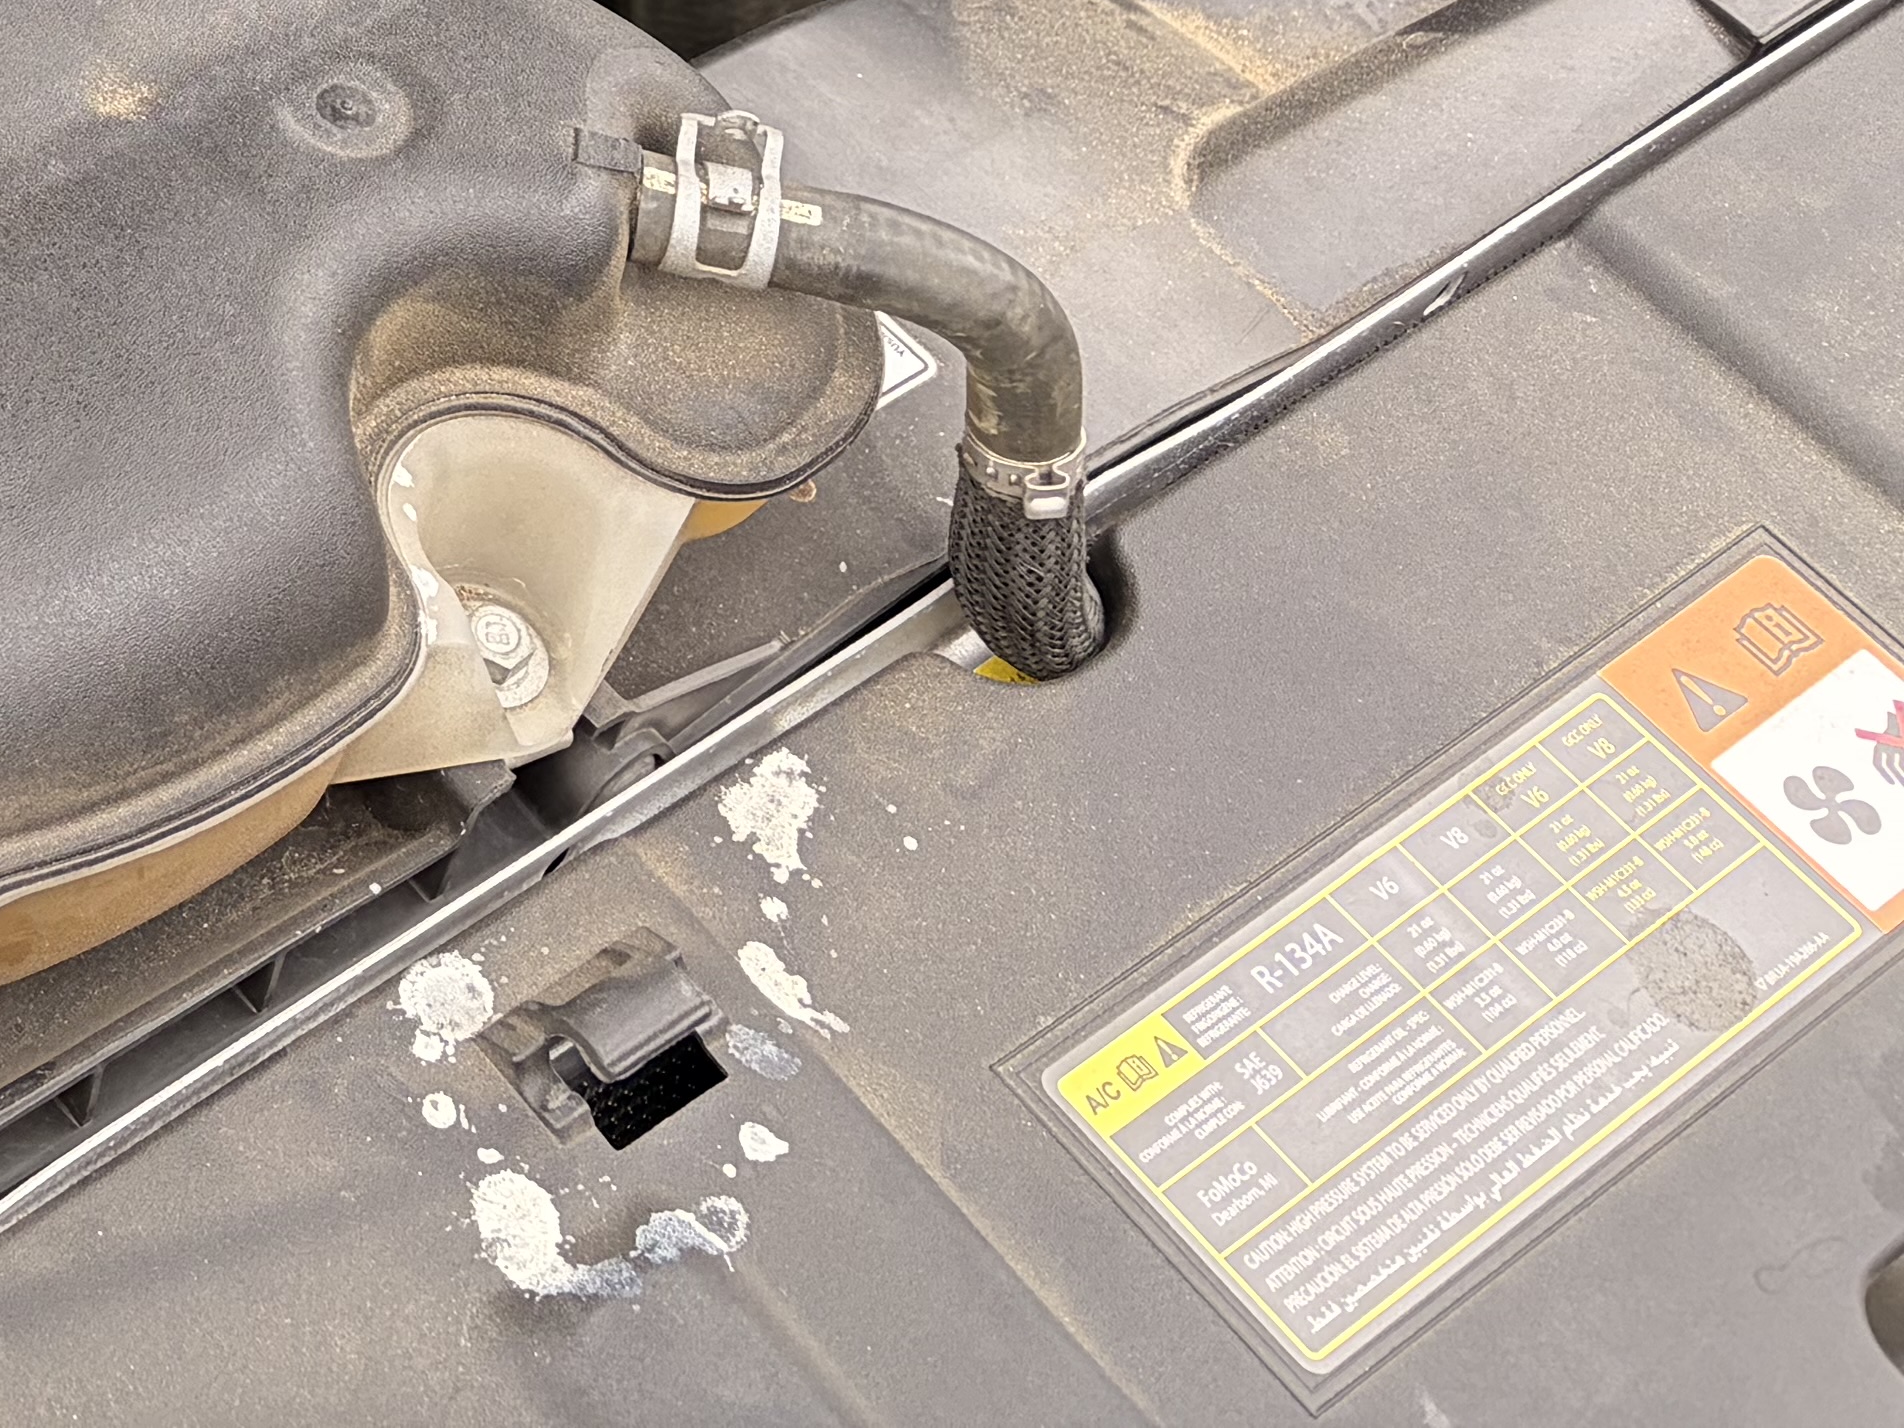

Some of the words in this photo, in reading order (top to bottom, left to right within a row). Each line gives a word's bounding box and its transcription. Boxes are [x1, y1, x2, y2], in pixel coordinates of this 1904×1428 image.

[1560, 728, 1584, 747] GCC
[1577, 712, 1603, 735] ONLY
[1586, 737, 1616, 759] V8
[1511, 761, 1537, 784] ONLY
[1614, 771, 1630, 785] 21
[1519, 785, 1550, 808] V6
[1439, 826, 1469, 849] V8
[1548, 820, 1563, 834] 21
[1368, 875, 1400, 900] V6
[1478, 871, 1494, 885] 21
[1406, 923, 1423, 939] 21
[1250, 923, 1343, 993] R-134A
[1234, 1050, 1266, 1080] SAE
[1249, 1064, 1283, 1095] J639
[1080, 1079, 1124, 1115] A/C
[1243, 1229, 1293, 1269] CAUTION:
[1285, 1210, 1317, 1237] HIGH
[1308, 1177, 1360, 1219] PRESSURE
[1352, 1151, 1393, 1187] SYSTEM
[1384, 1141, 1406, 1160] TO
[1398, 1131, 1419, 1151] BE
[1410, 1102, 1457, 1142] SERVICED
[1450, 1083, 1480, 1111] ONLY
[1472, 1074, 1492, 1094] BY
[1485, 1042, 1536, 1084] QUALIFIED
[1316, 1215, 1357, 1251] CIRCUIT
[1351, 1196, 1383, 1226] SOUS
[1375, 1173, 1414, 1206] HAUTE
[1404, 1141, 1454, 1183] PRESSION
[1452, 1095, 1514, 1145] TECHNICIENS
[1507, 1062, 1557, 1104] QUALIFIÉS
[1339, 1252, 1360, 1270] EL
[1350, 1224, 1395, 1261] SISTEMA
[1385, 1213, 1408, 1234] DE
[1399, 1199, 1428, 1224] ALTA
[1419, 1172, 1463, 1208] PRESIÓN
[1477, 1136, 1508, 1163] DEBE
[1498, 1124, 1523, 1146] SER
[1514, 1094, 1562, 1134] REVISADO
[1554, 1079, 1581, 1103] POR
[1572, 1049, 1622, 1088] PERSONAL
[1196, 1161, 1257, 1208] FoMoCo
[1210, 1186, 1266, 1227] Dearborn,
[1257, 1171, 1279, 1191] MI
